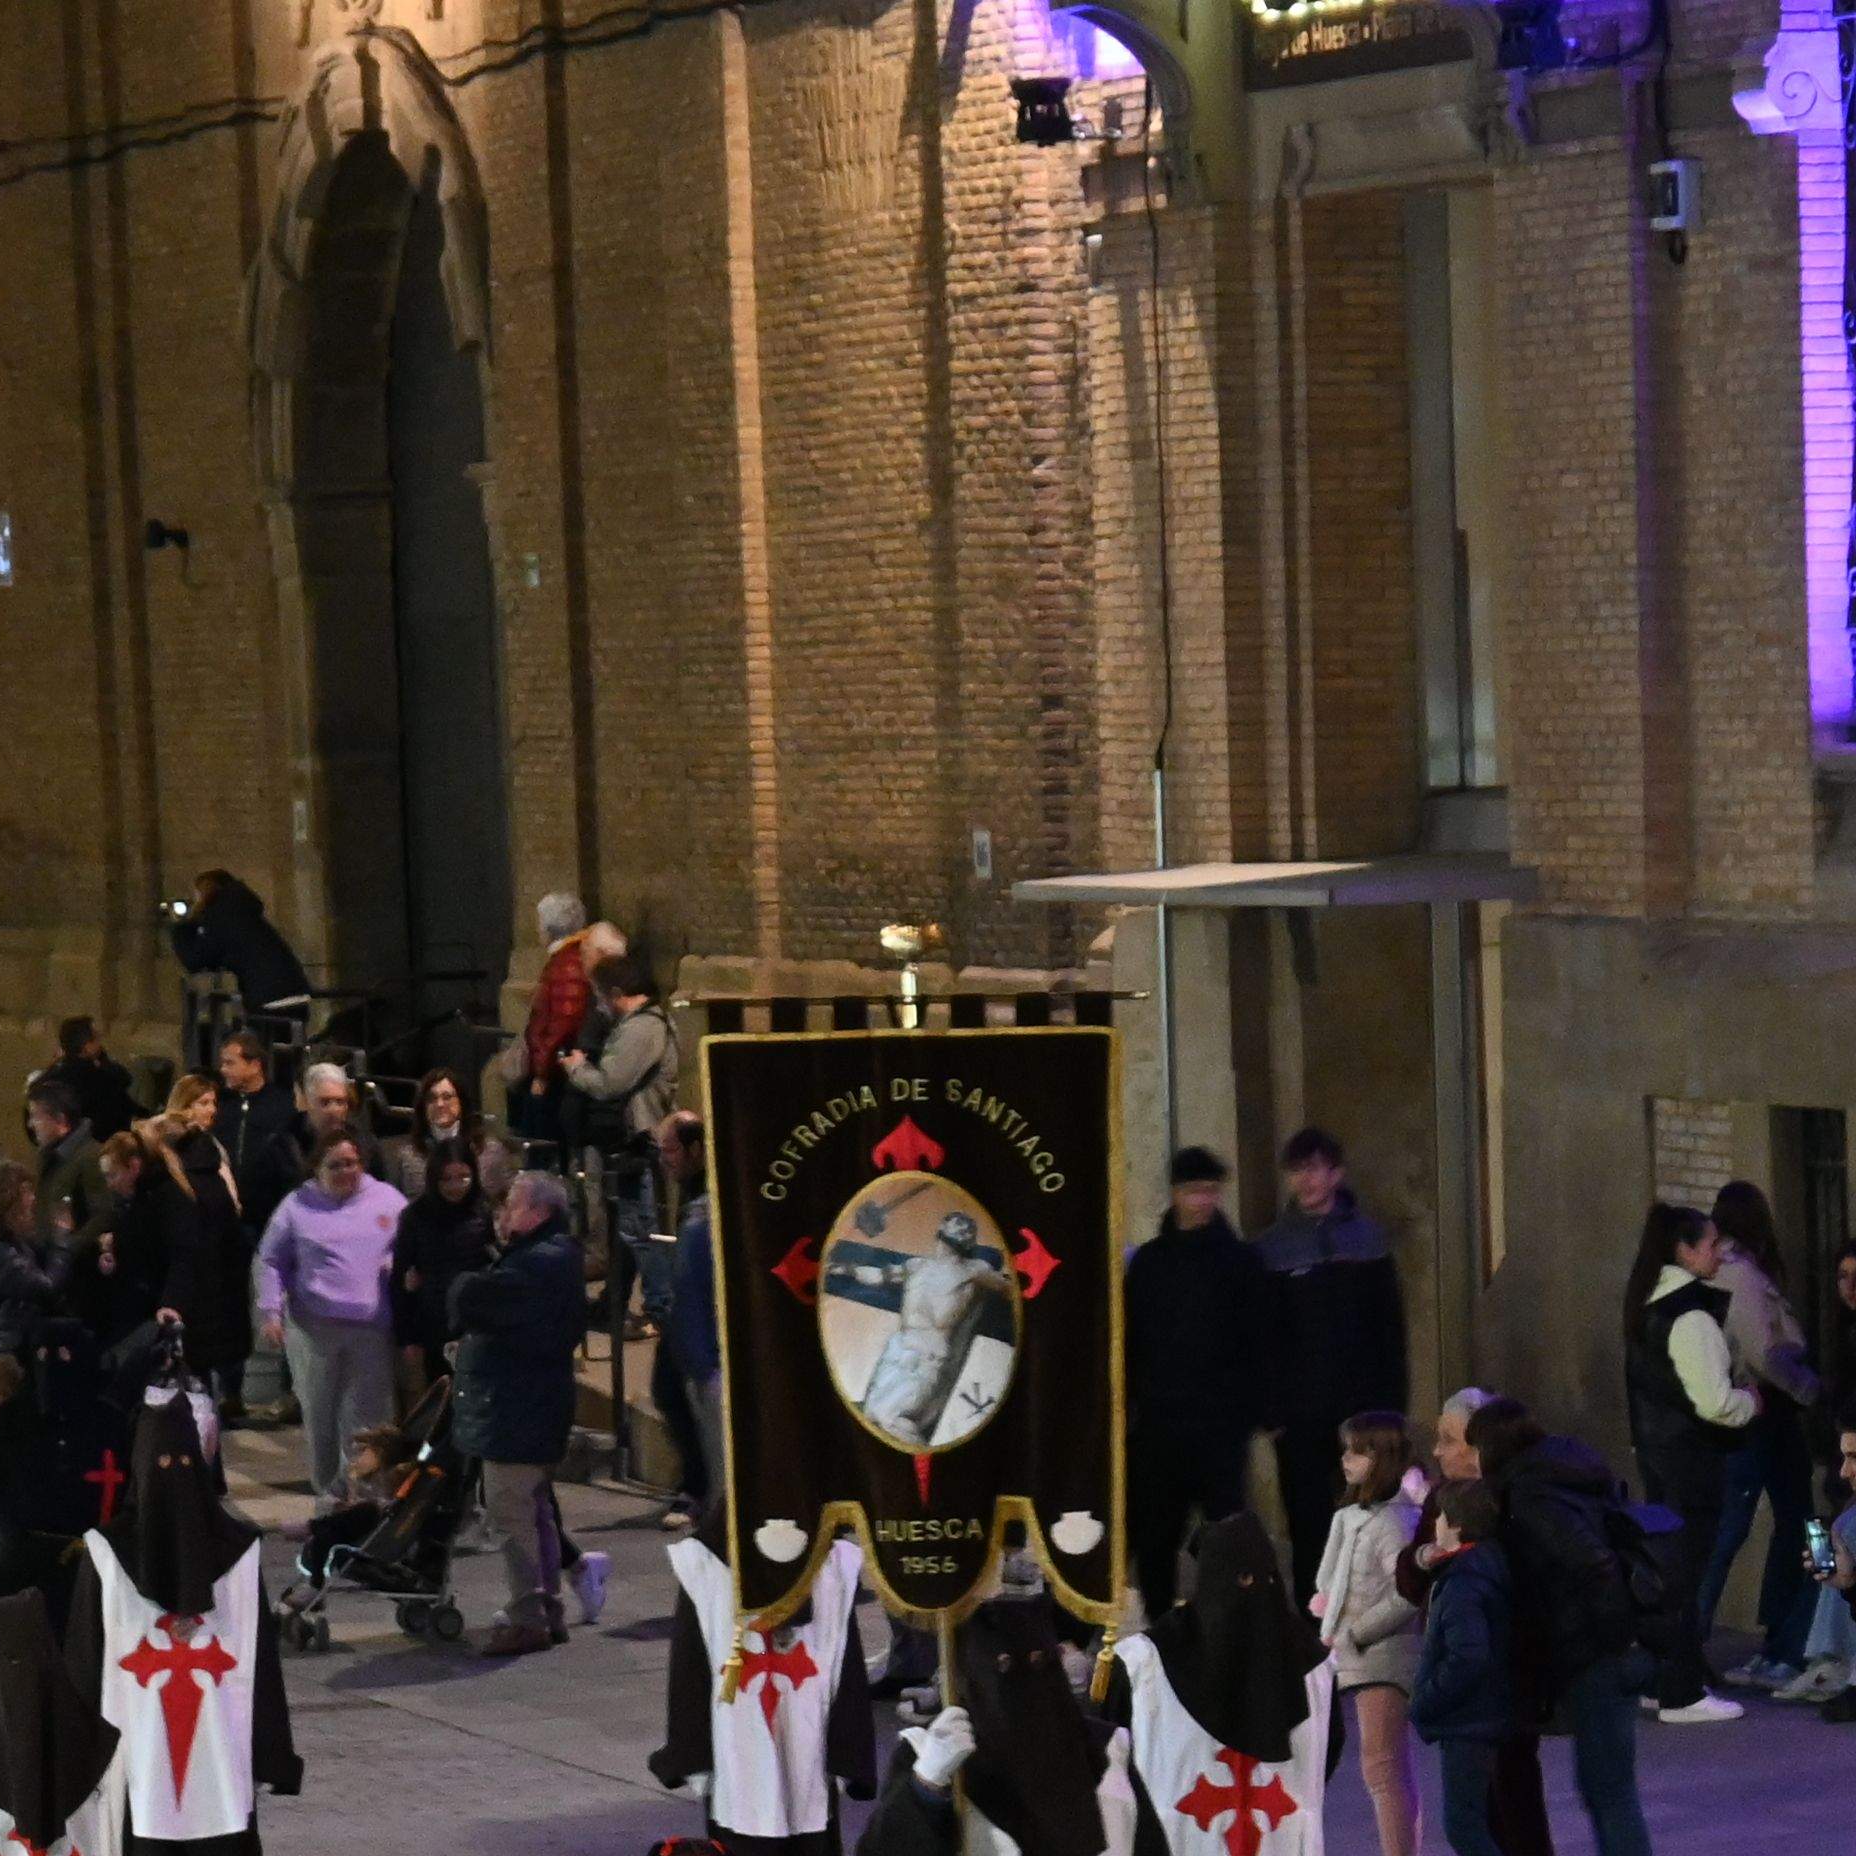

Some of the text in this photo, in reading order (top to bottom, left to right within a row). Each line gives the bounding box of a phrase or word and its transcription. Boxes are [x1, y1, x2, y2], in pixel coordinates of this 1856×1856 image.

[761, 1078, 1066, 1203] COFRADIA DE SANTIAGO
[876, 1520, 985, 1543] HUESCA
[899, 1555, 959, 1577] 1956
